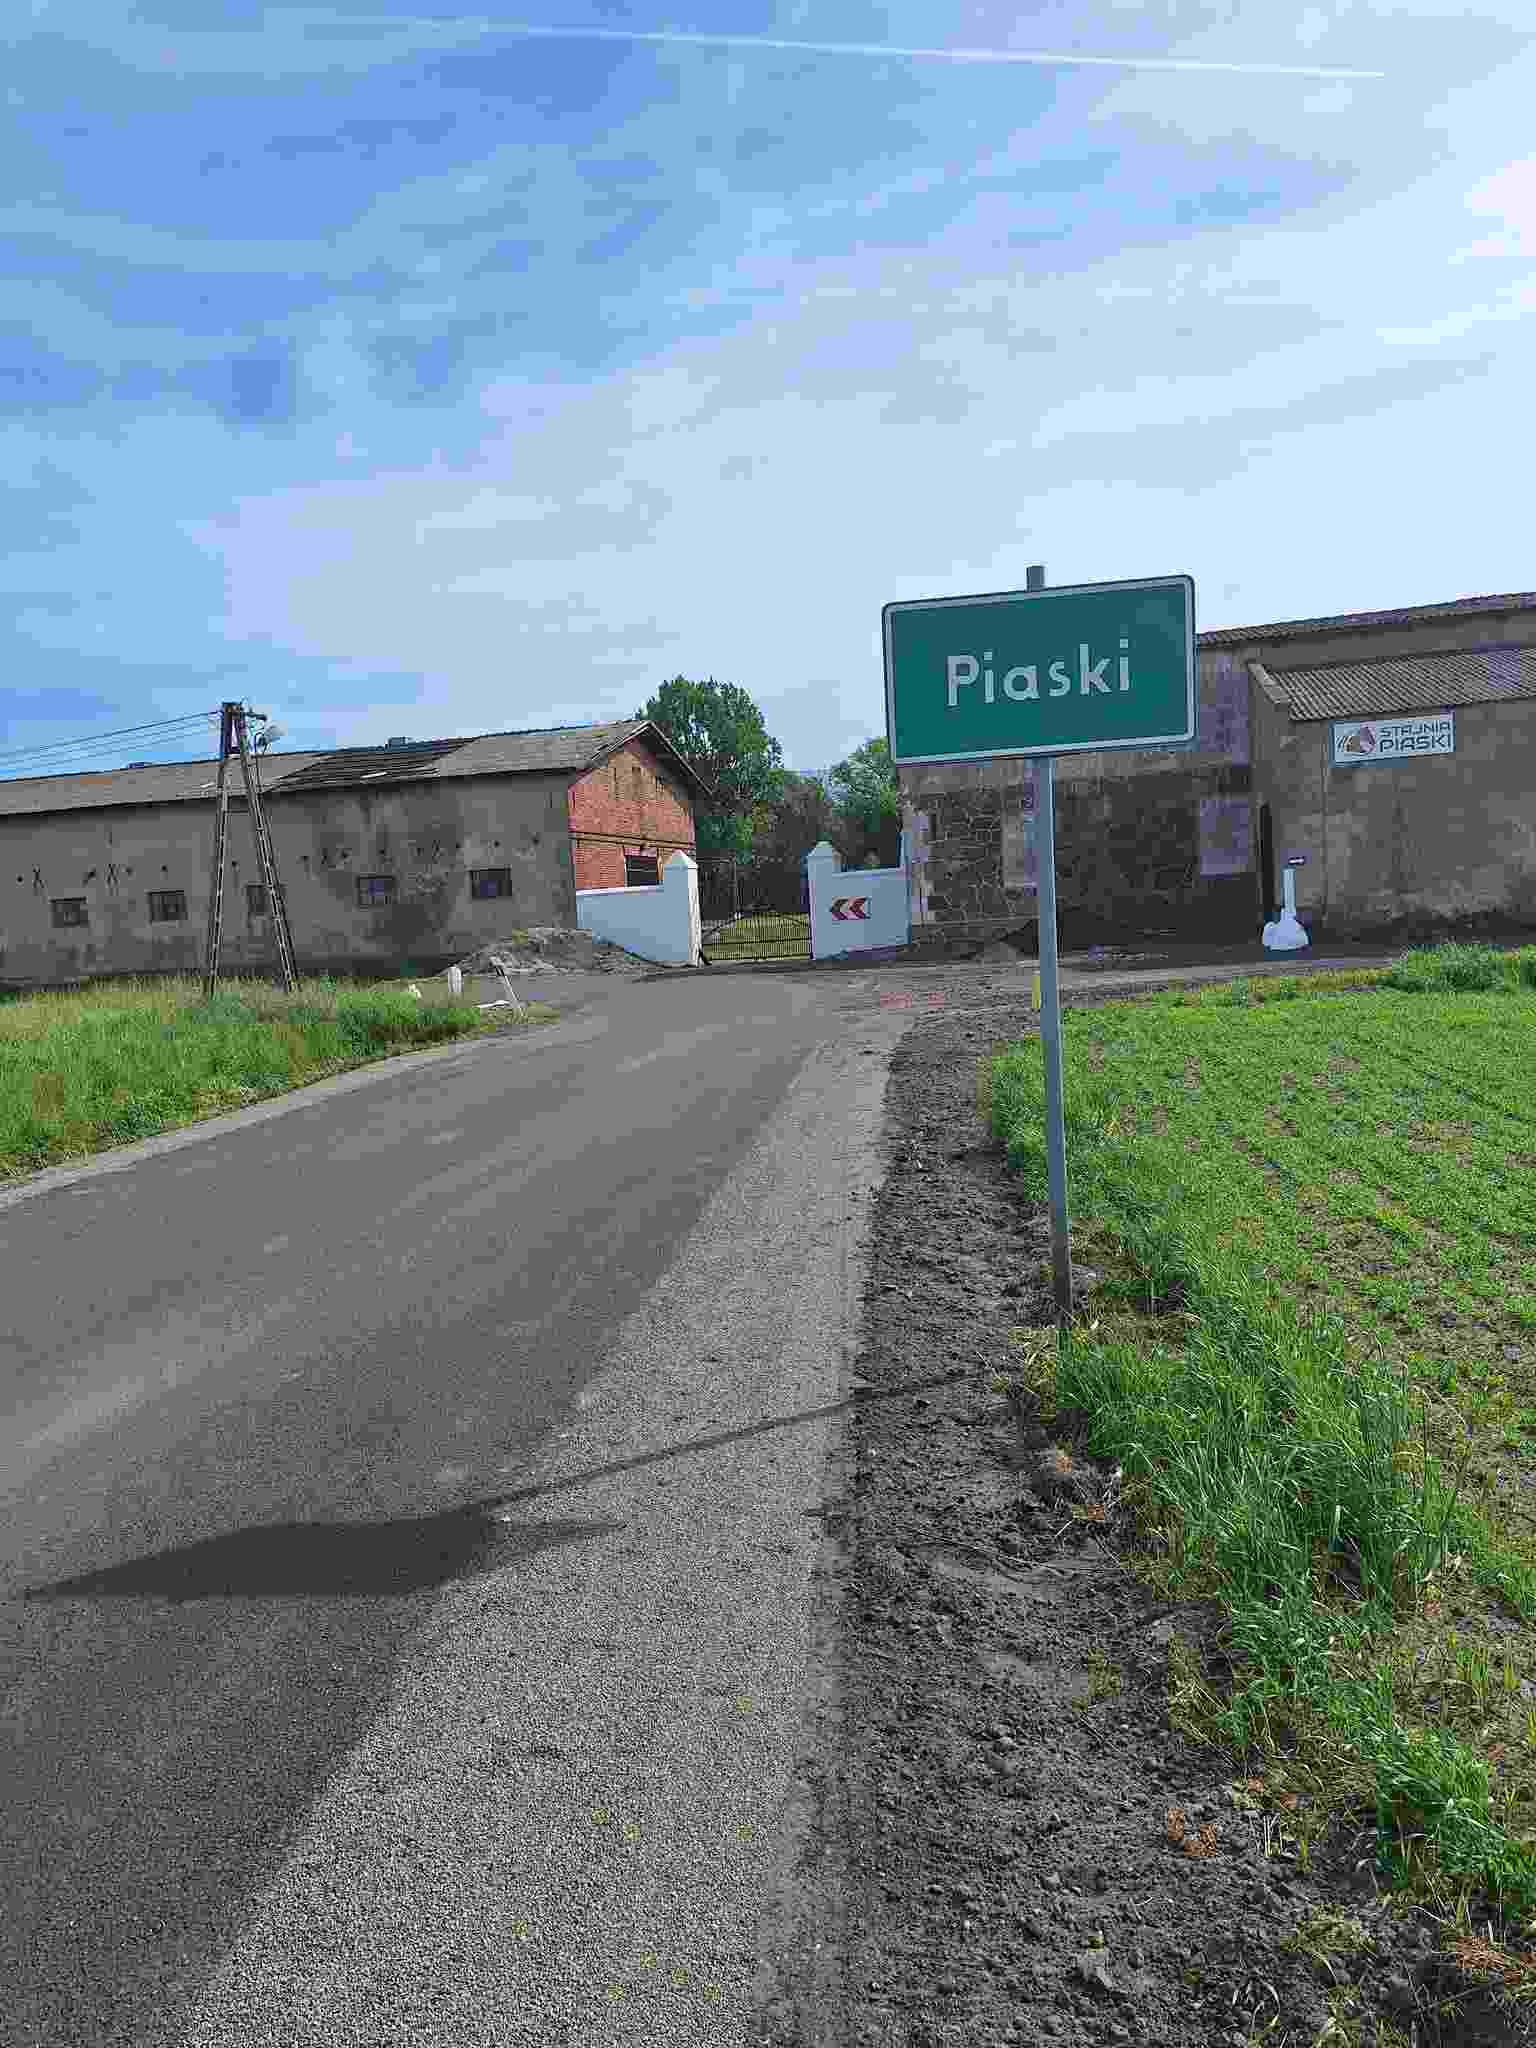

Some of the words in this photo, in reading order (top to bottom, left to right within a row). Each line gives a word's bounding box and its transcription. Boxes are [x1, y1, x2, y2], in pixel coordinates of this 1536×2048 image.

[946, 638, 1130, 707] Piaski
[1380, 721, 1451, 737] STAJNIA
[1380, 735, 1451, 752] PIASKI
